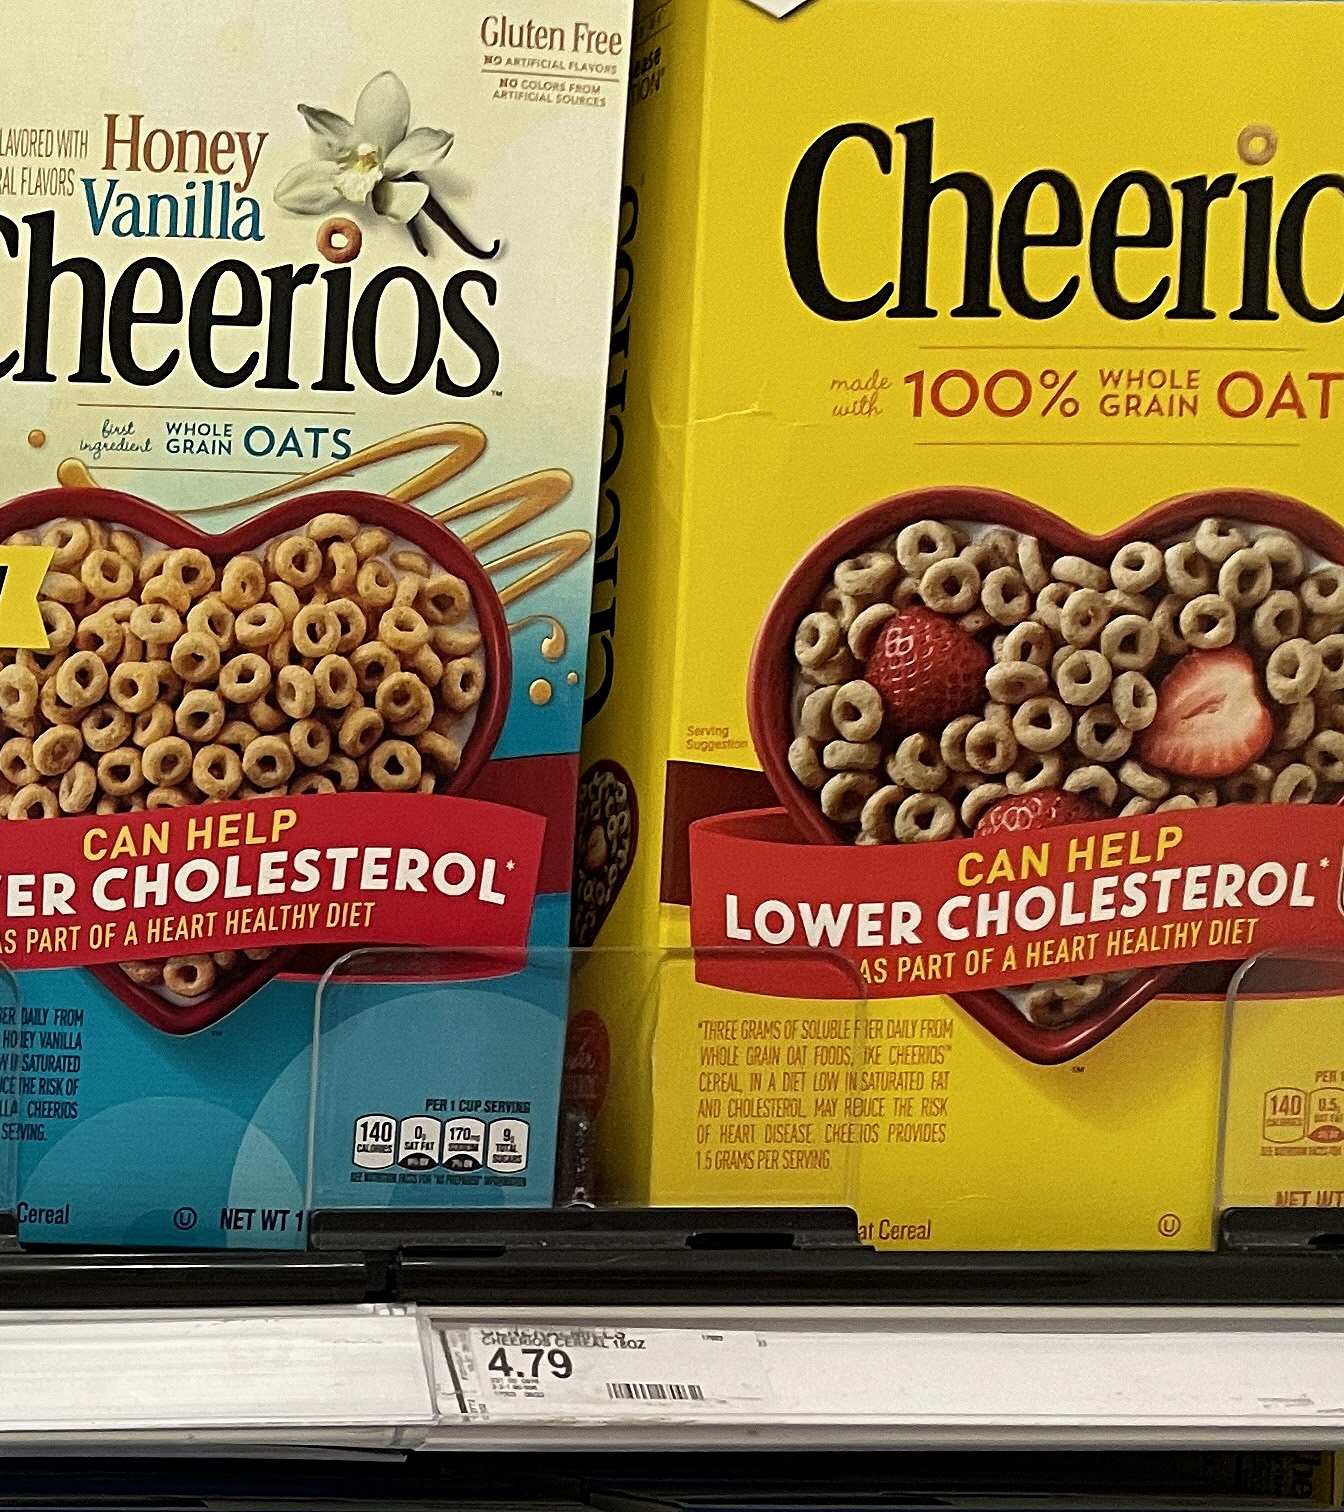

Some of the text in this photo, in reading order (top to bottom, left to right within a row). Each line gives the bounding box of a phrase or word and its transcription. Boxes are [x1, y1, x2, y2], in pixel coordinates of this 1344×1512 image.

[481, 15, 623, 56] Gluten Free
[56, 130, 87, 158] WITH
[102, 114, 267, 193] Honey
[22, 169, 73, 197] FLAVORS
[81, 178, 264, 241] Vanilla
[905, 368, 1080, 418] 100%
[1099, 369, 1200, 390] WHOLE
[1100, 395, 1197, 417] GRAIN
[166, 422, 232, 437] WHOLE
[166, 440, 232, 456] GRAIN
[244, 426, 352, 460] OATS
[83, 809, 298, 861] CAN HELP
[958, 827, 1183, 886] CAN HELP
[25, 925, 79, 952] PART
[90, 923, 116, 948] OF
[123, 921, 138, 945] A
[147, 913, 216, 942] HEART
[225, 904, 318, 935] HEALTHY
[326, 902, 376, 928] DIET
[727, 895, 923, 947] LOWER
[489, 1348, 573, 1378] 4.79
